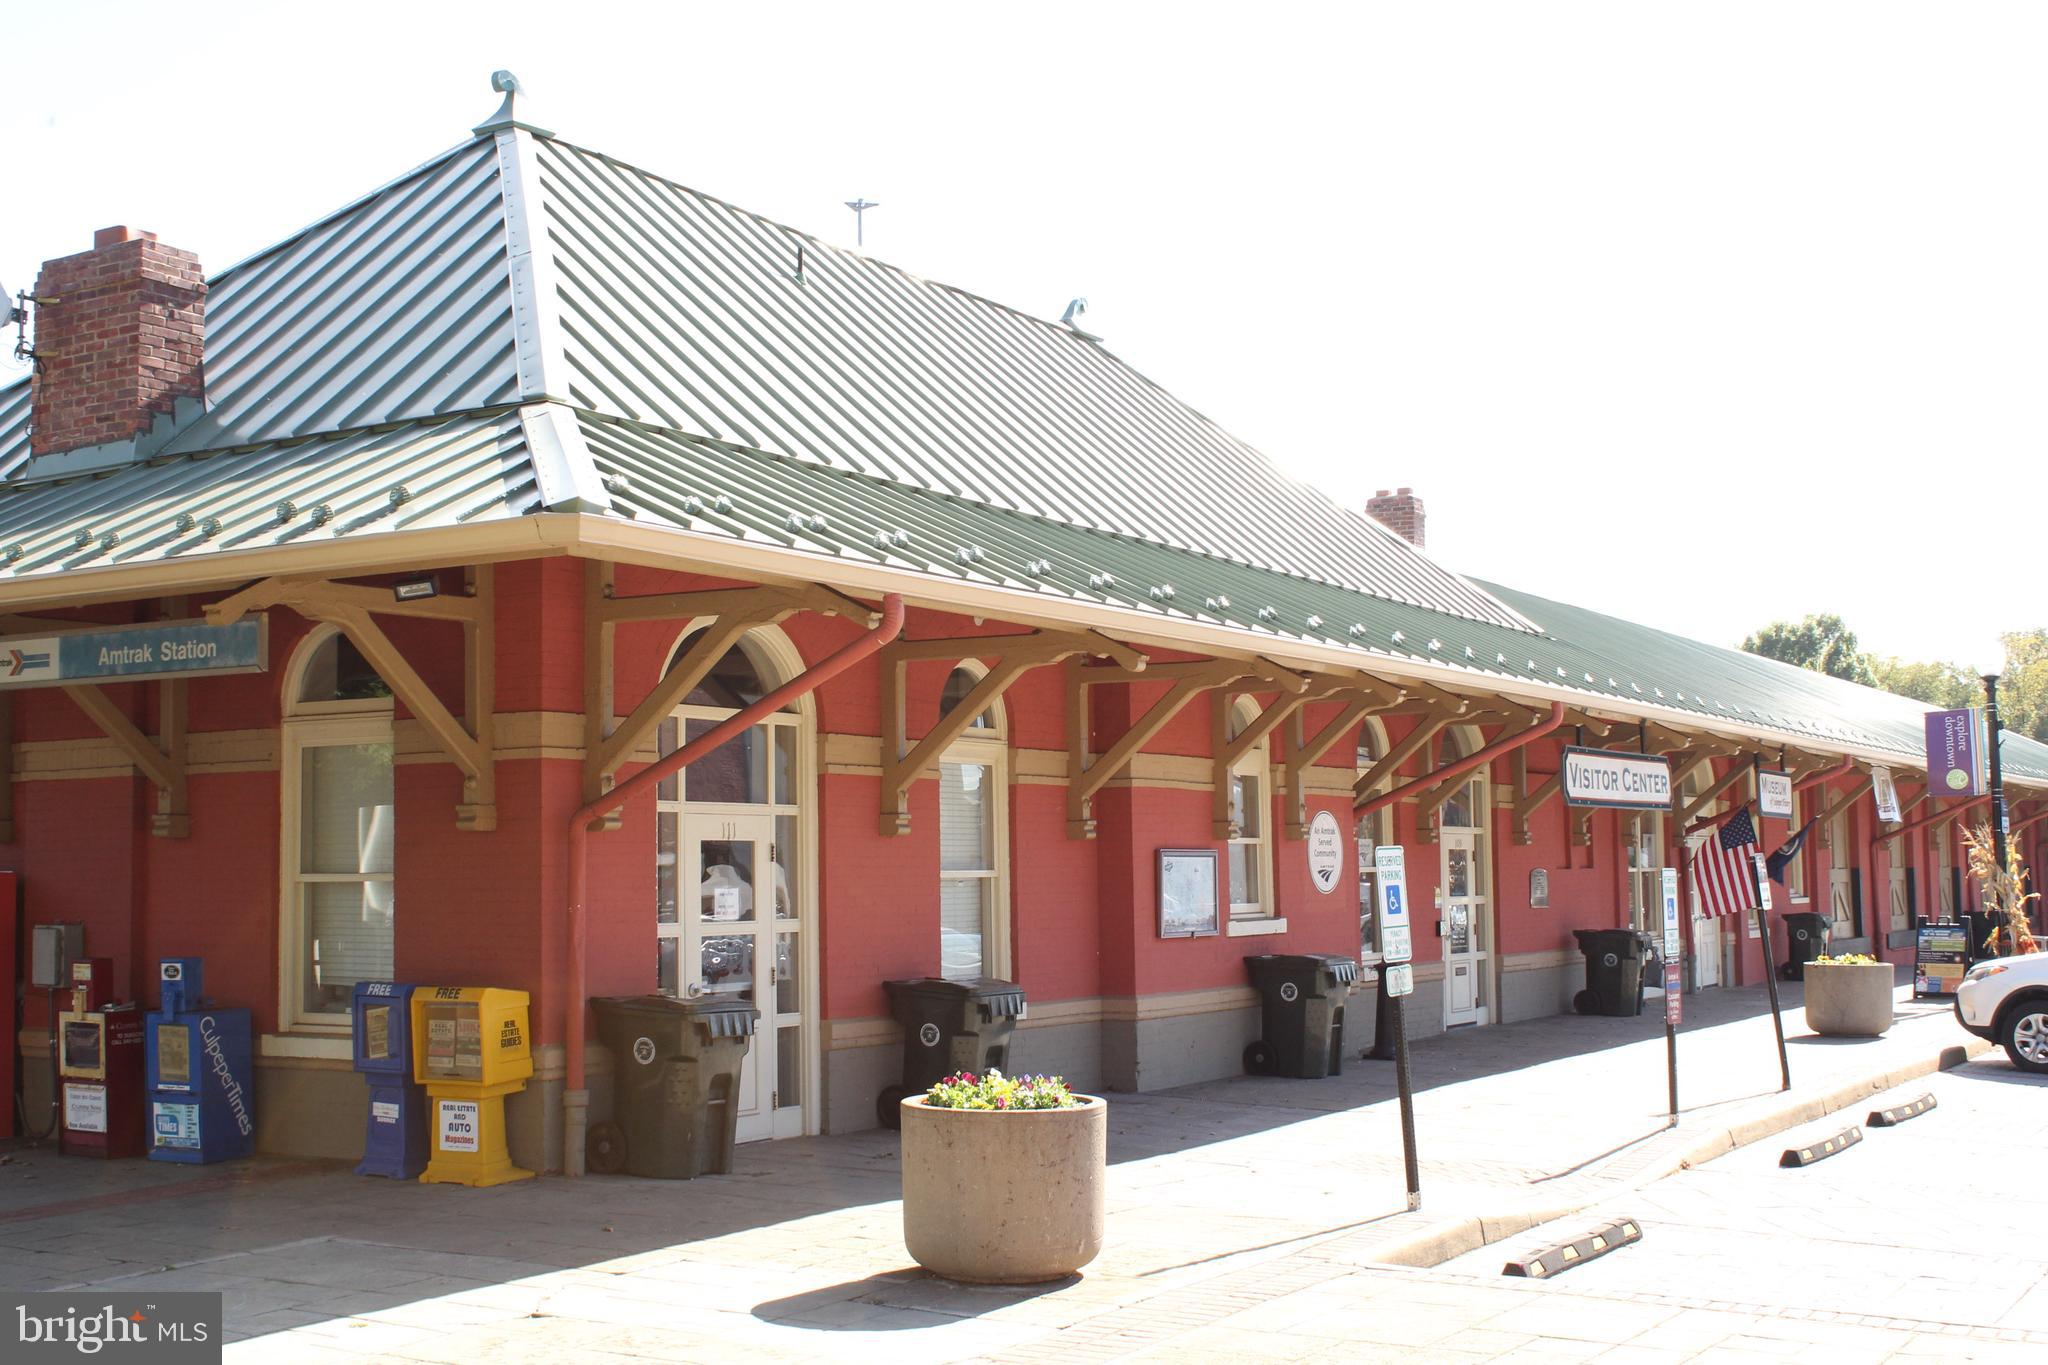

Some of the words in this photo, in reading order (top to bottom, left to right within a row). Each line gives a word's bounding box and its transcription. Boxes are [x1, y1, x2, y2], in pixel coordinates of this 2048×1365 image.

[98, 644, 153, 666] Amtrak
[160, 639, 217, 661] Station
[1956, 715, 1968, 751] explore
[1944, 716, 1956, 768] downtown
[1569, 762, 1619, 791] VISITOR
[1622, 767, 1669, 794] CENTER
[1761, 777, 1787, 797] MUSEUM
[1377, 855, 1402, 867] RESERVED
[1380, 869, 1402, 880] PARKING
[367, 983, 393, 996] FREE
[435, 987, 462, 999] FREE
[503, 1019, 516, 1028] REAL
[501, 1027, 520, 1038] ESTATE
[500, 1036, 522, 1049] GUIDES
[442, 1104, 456, 1112] REAL
[457, 1105, 476, 1113] ESTATE
[448, 1122, 472, 1133] AUTO
[445, 1134, 475, 1145] Magazines
